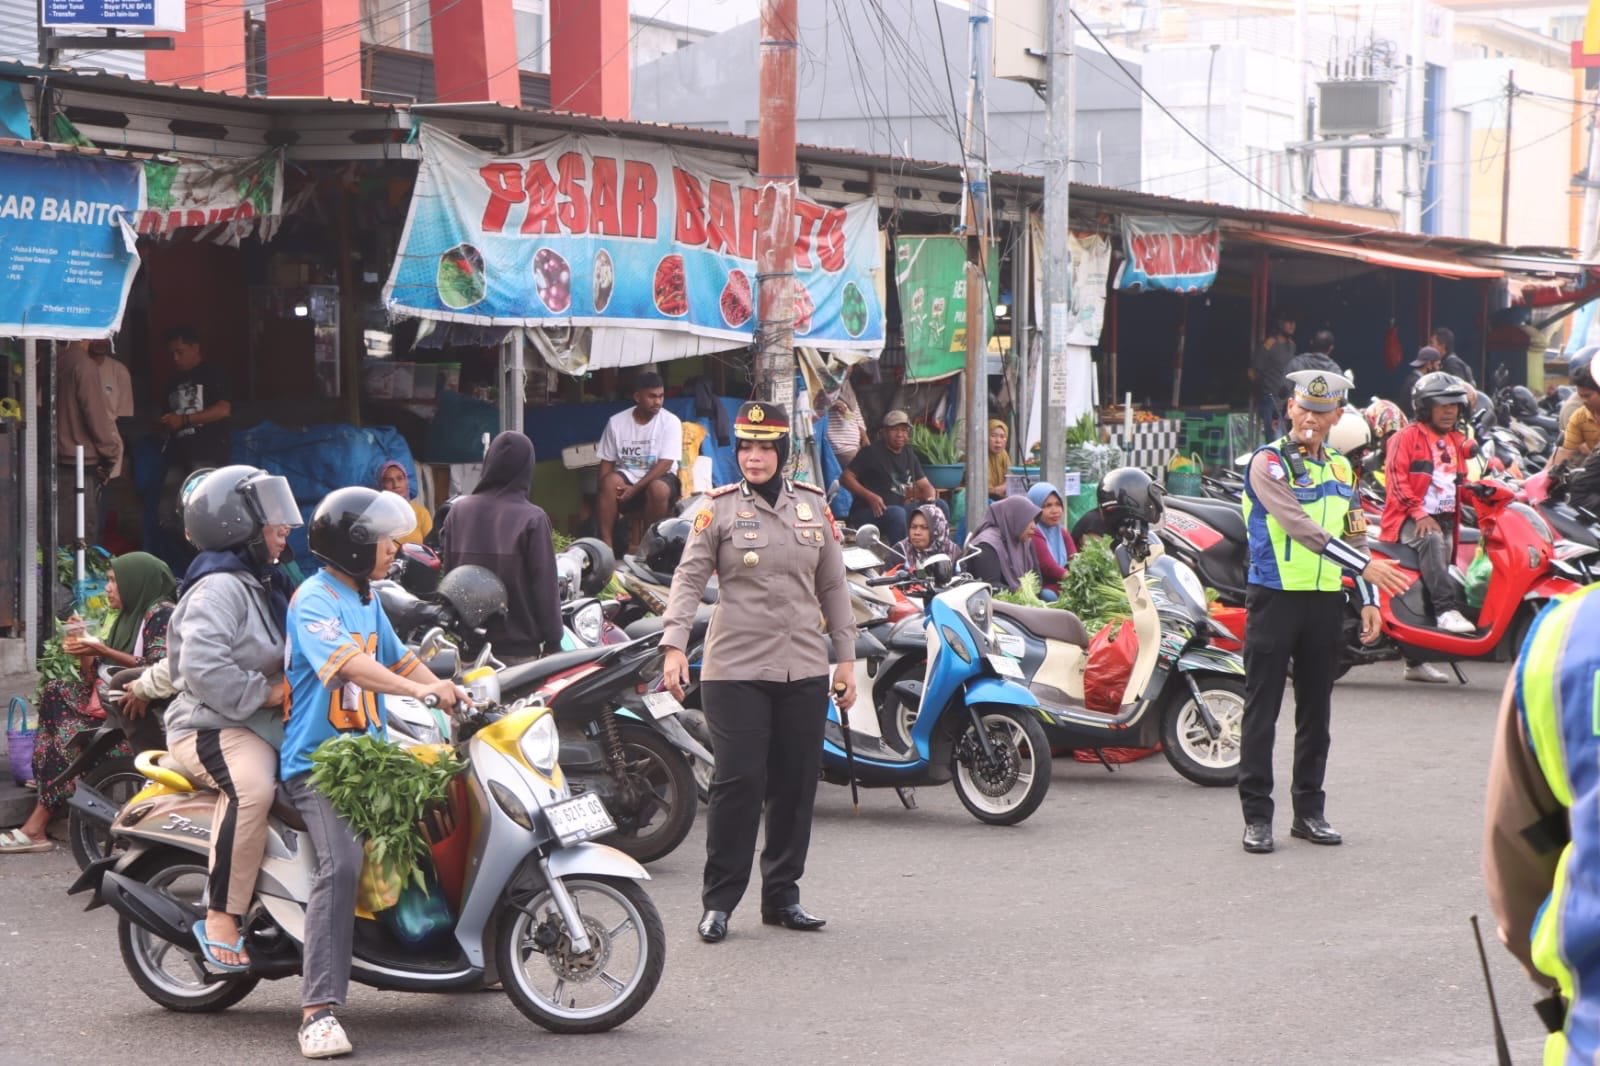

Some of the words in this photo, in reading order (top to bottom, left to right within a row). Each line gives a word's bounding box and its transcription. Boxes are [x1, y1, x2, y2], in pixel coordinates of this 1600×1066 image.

[479, 151, 658, 239] PASAR
[40, 197, 127, 228] BARITO
[622, 447, 641, 456] NYC
